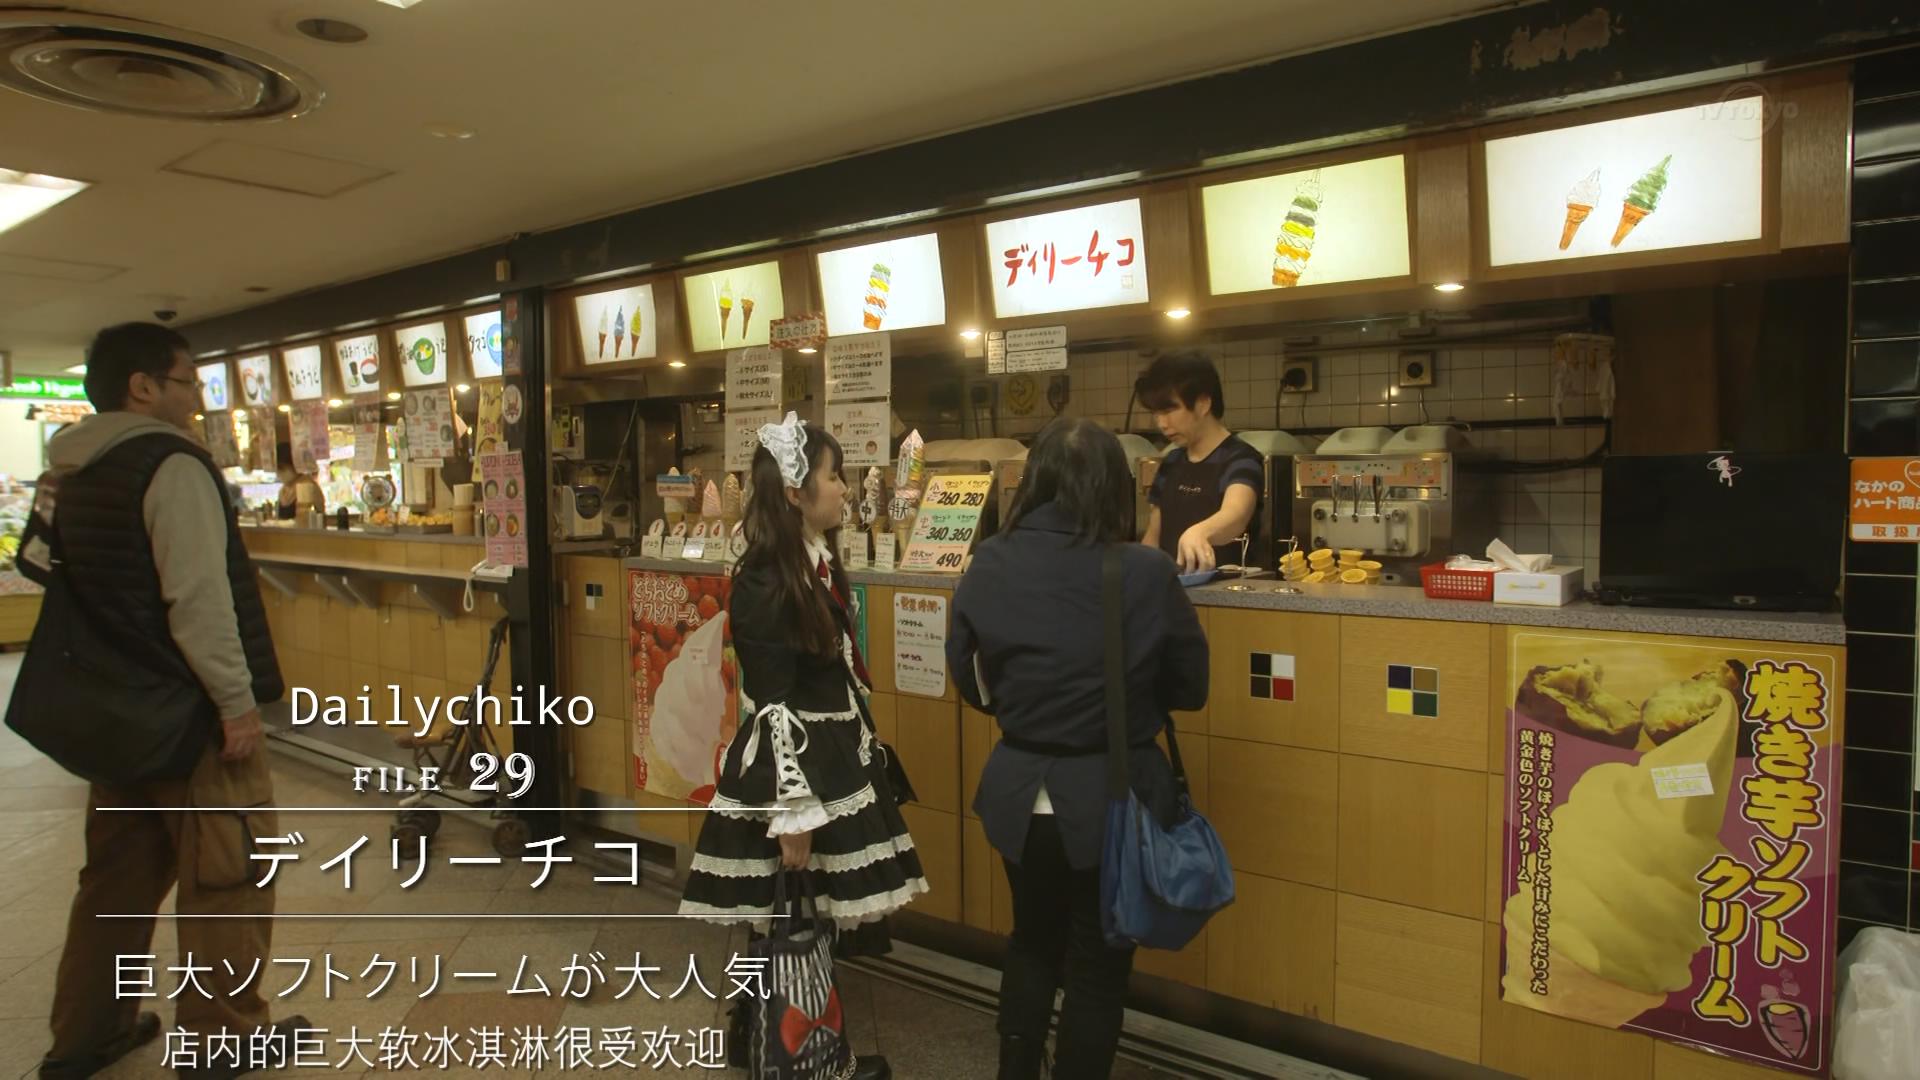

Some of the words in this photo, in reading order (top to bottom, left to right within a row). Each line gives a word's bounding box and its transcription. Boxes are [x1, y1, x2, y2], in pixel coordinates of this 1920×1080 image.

[1855, 480, 1905, 493] なかの
[937, 491, 961, 506] 260
[961, 491, 985, 507] 280
[861, 501, 872, 523] 中
[674, 525, 684, 536] 2
[696, 524, 705, 536] 3
[926, 526, 949, 542] 340
[948, 527, 973, 542] 360
[1872, 526, 1920, 538] 取扱
[936, 552, 962, 568] 490
[632, 602, 702, 626] ソフトクリーム
[1517, 728, 1536, 883] 黄金色のソフトクリーム
[1743, 661, 1828, 968] 焼き芋ソフト
[1531, 730, 1555, 996] 焼き芋のほくほくとした甘みにこだわった
[1695, 855, 1755, 1026] クリーム
